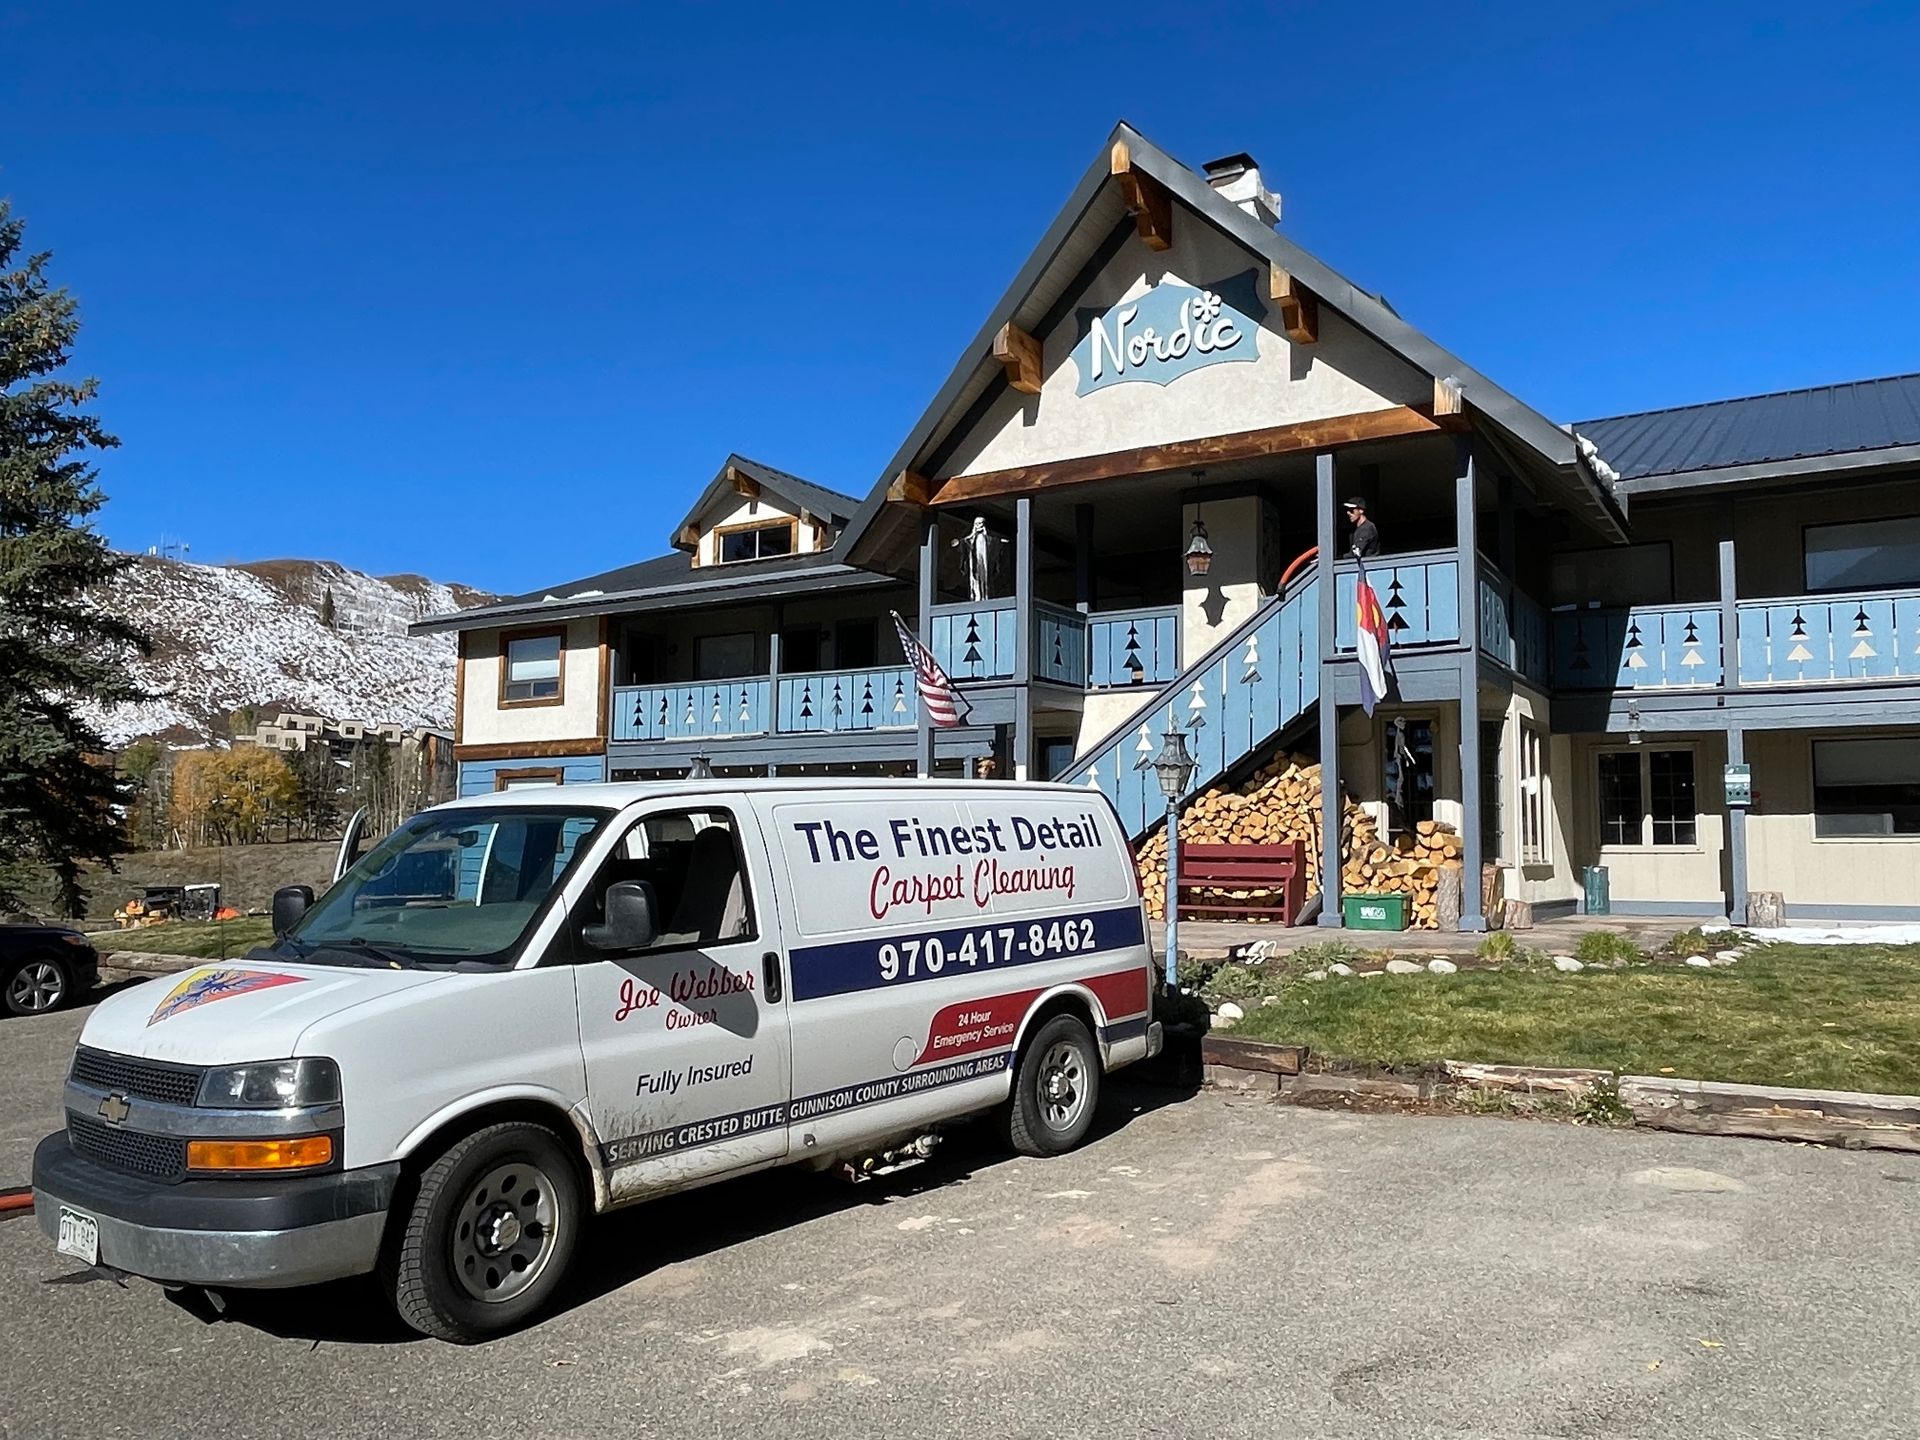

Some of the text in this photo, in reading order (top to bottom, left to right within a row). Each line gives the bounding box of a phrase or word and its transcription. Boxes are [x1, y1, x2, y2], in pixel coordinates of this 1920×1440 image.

[1091, 291, 1242, 381] Nordic
[794, 814, 1102, 863] The Finest Detail
[870, 855, 1075, 919] Carpet Cleaning
[878, 918, 1096, 980] 970-417-8462
[615, 966, 755, 1022] Joe Webber
[666, 1008, 718, 1030] Owner
[958, 1011, 992, 1027] 24 Hour
[933, 1022, 1015, 1048] Emergency Service
[636, 1054, 753, 1096] Fully Insured
[609, 1055, 1004, 1162] SERVING CRESTED BUTTE, GUNNISON COUNTY SURROUNDING AREAS
